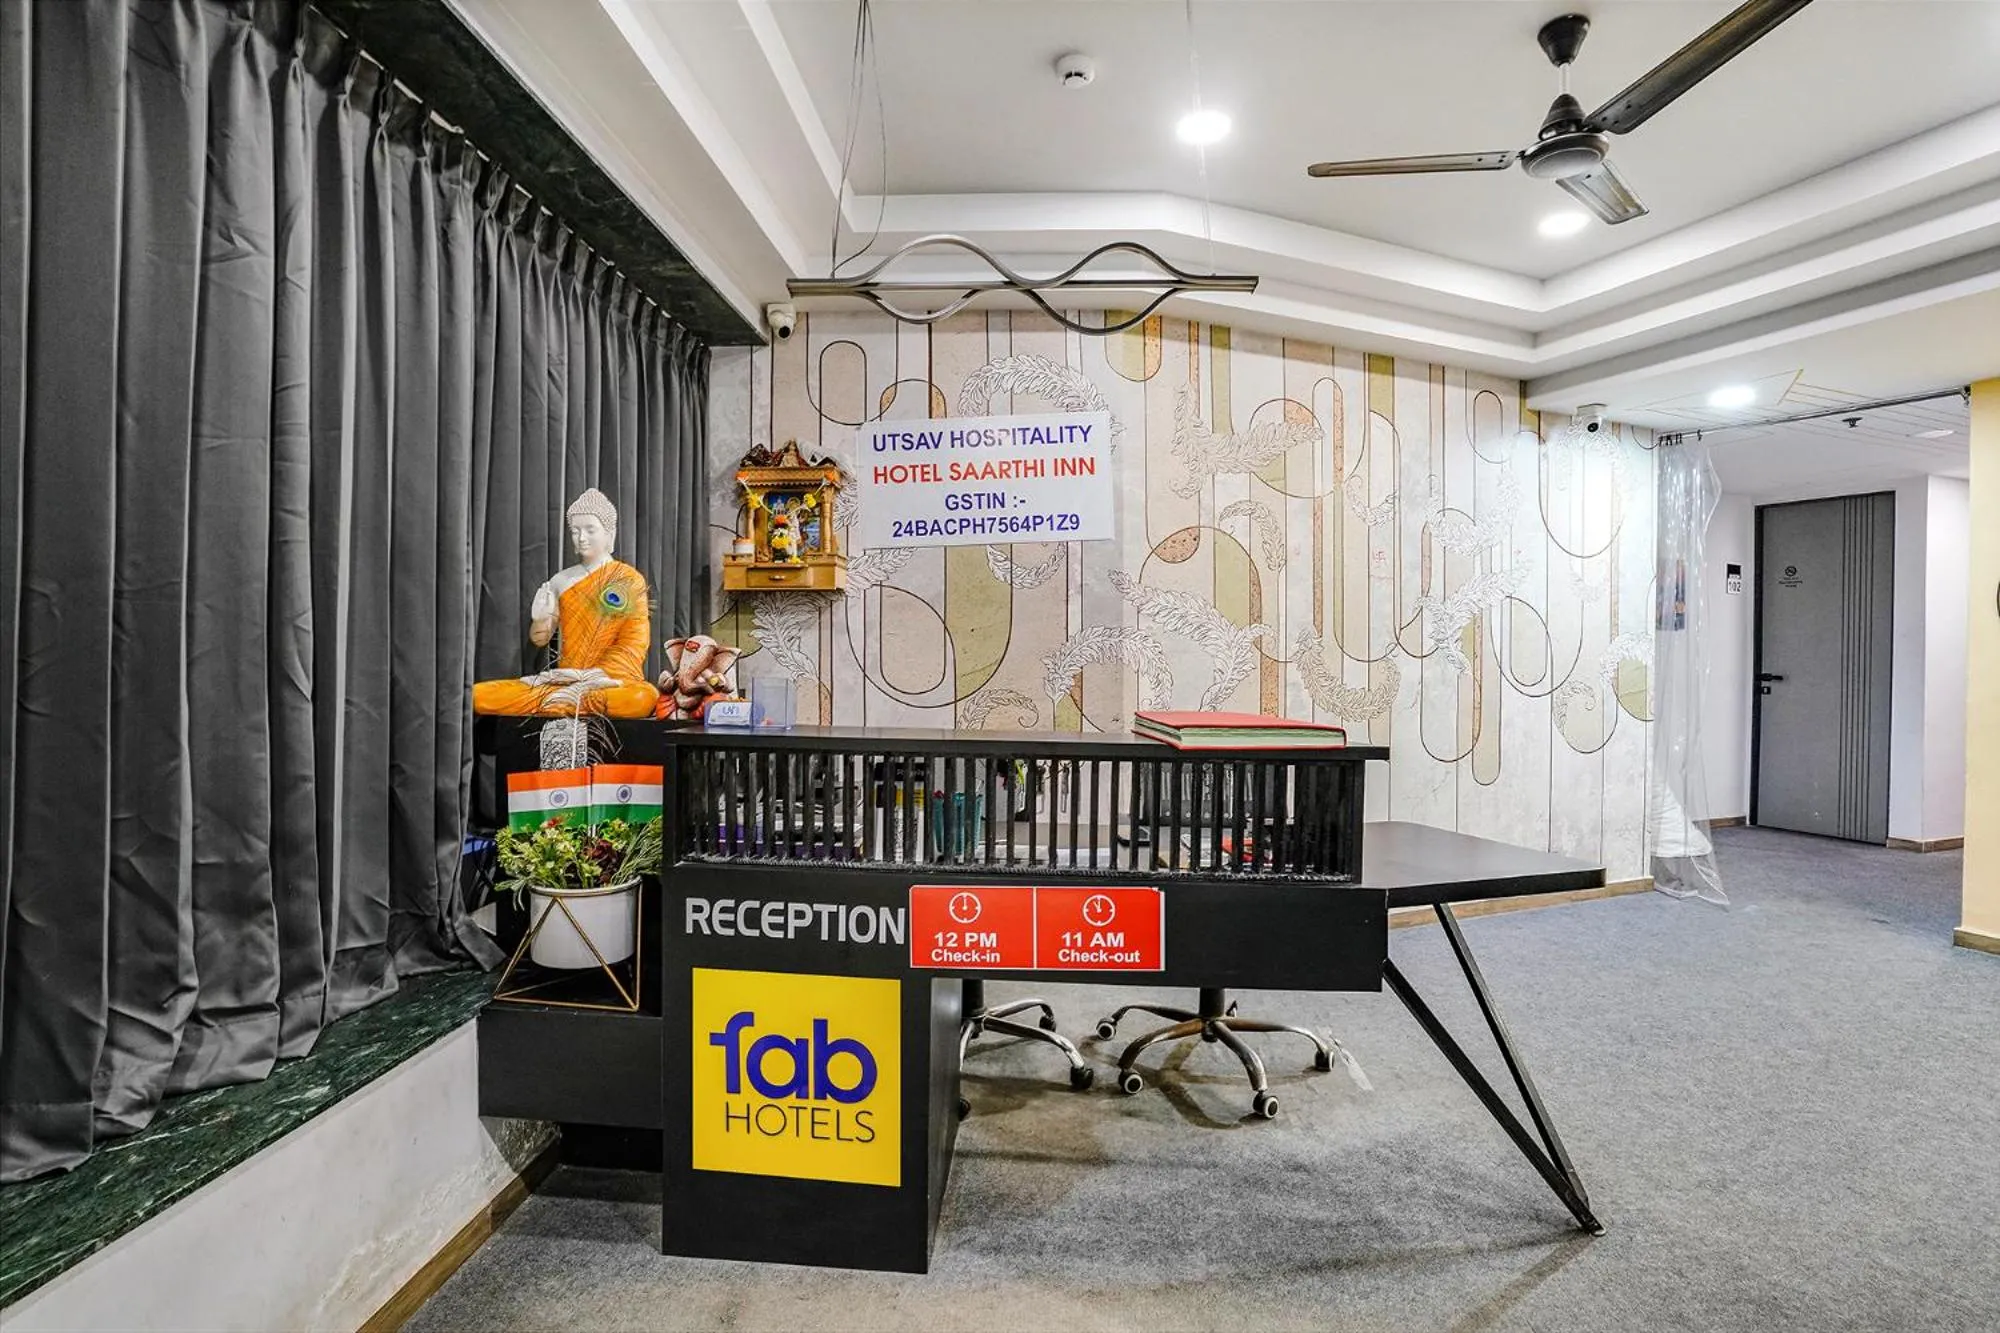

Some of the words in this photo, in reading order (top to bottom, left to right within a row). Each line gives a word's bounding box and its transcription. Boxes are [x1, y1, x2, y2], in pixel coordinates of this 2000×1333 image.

[872, 432, 944, 452] UTSAV
[950, 425, 1093, 448] HOSPITALITY
[873, 464, 943, 484] HOTEL
[949, 459, 1045, 481] SAARTHI
[1053, 457, 1096, 476] INN
[945, 492, 1005, 511] GSTIN
[892, 514, 1080, 538] 24BACPH7564P1Z9
[685, 897, 906, 945] RECEPTION
[934, 933, 957, 947] 12
[964, 933, 998, 948] PM
[1061, 933, 1084, 947] 11
[1090, 933, 1125, 948] AM
[931, 948, 1001, 963] Check-in
[1058, 949, 1141, 964] Check-out
[709, 1011, 878, 1104] fab
[725, 1102, 875, 1143] HOTELS
